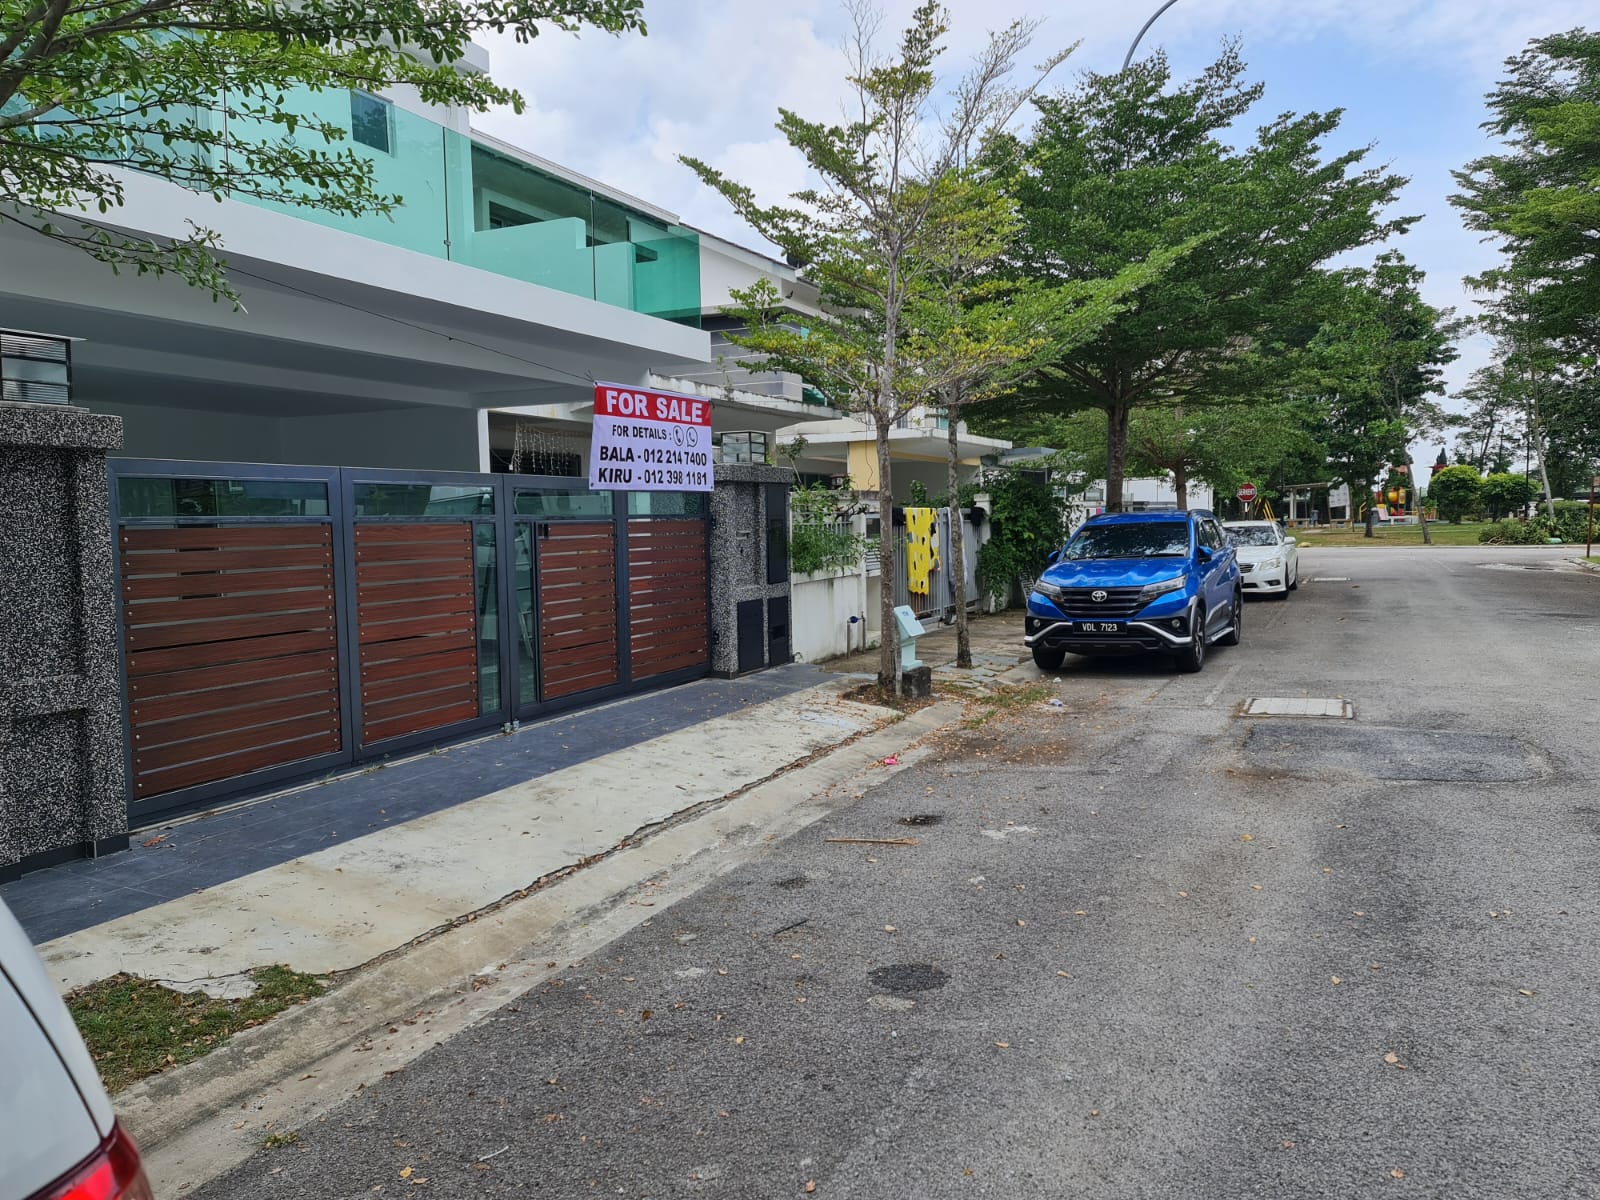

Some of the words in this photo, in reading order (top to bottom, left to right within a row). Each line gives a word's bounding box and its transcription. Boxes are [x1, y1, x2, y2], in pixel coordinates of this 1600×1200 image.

[606, 390, 649, 417] FOR
[656, 397, 703, 424] SALE
[612, 424, 629, 438] FOR
[632, 425, 667, 441] DETAILS
[600, 446, 634, 462] BALA
[643, 448, 663, 464] 012
[666, 449, 682, 465] 214
[684, 451, 707, 466] 7400
[598, 467, 632, 484] KIRU
[644, 469, 664, 484] 012
[666, 470, 683, 485] 398
[686, 471, 707, 485] 1181
[1082, 623, 1097, 632] VDL
[1100, 623, 1118, 632] 7123
